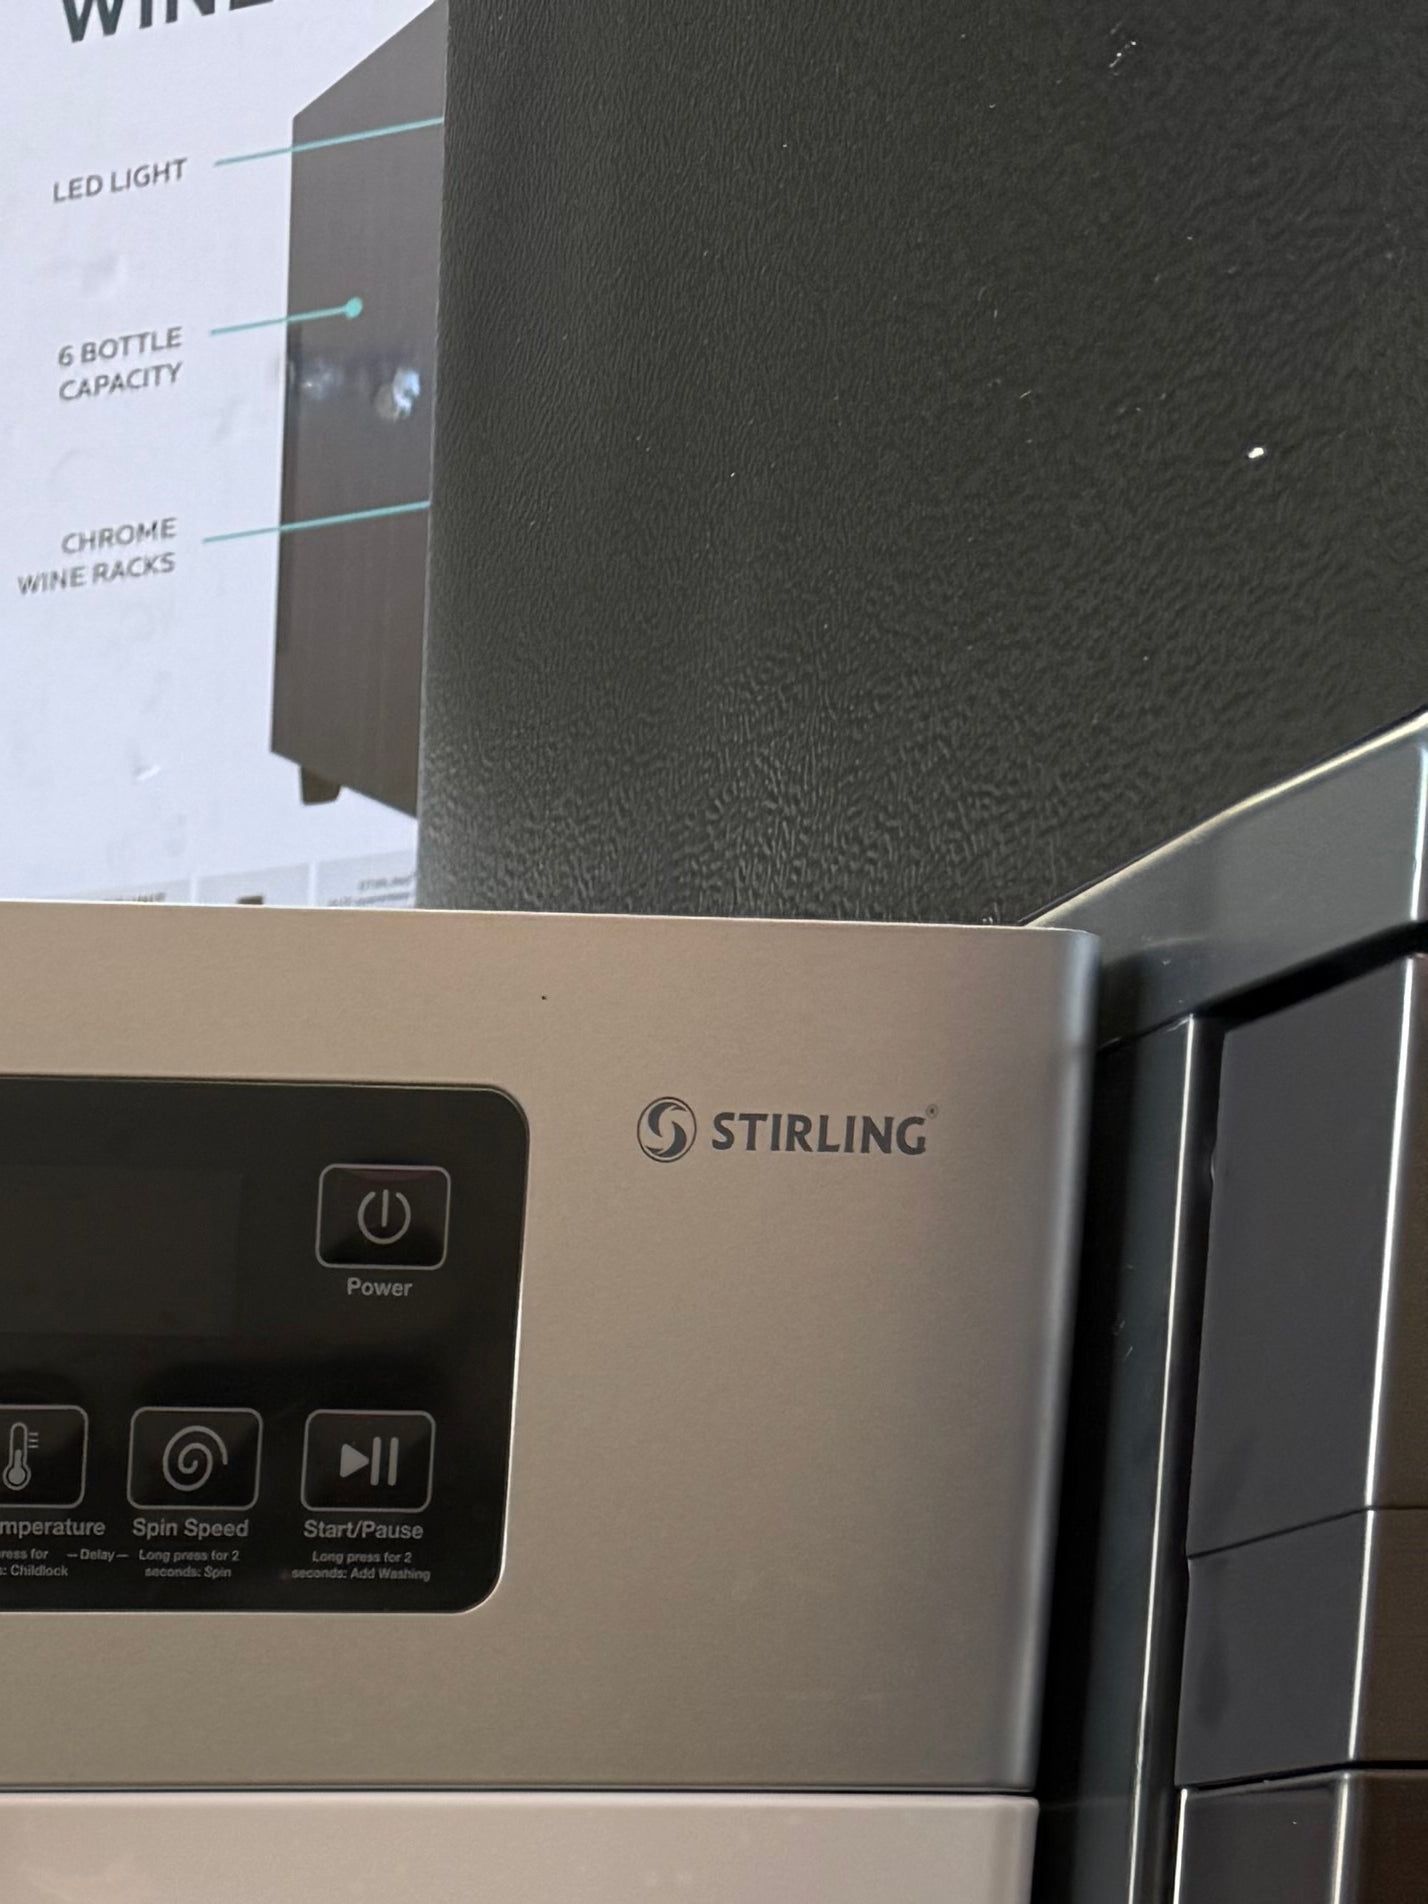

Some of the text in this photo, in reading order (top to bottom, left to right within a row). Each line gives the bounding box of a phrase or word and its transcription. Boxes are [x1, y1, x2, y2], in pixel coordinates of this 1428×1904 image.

[54, 158, 187, 203] LED LIGHT
[58, 327, 181, 366] 6 BOTTLE
[59, 362, 182, 401] CAPACITY
[62, 517, 176, 554] CHROME
[18, 552, 174, 595] WINE RACKS
[712, 1112, 926, 1155] STIRLING
[347, 1277, 412, 1296] Power
[133, 1518, 248, 1540] Spin Speed
[304, 1520, 423, 1539] Start/Pause
[31, 1549, 48, 1559] for
[139, 1549, 239, 1563] Long press for 2
[312, 1551, 411, 1564] Long press for 2
[11, 1564, 68, 1576] Childlock
[145, 1565, 231, 1579] seconds: Spin
[292, 1568, 430, 1582] seconds: Add Washing
